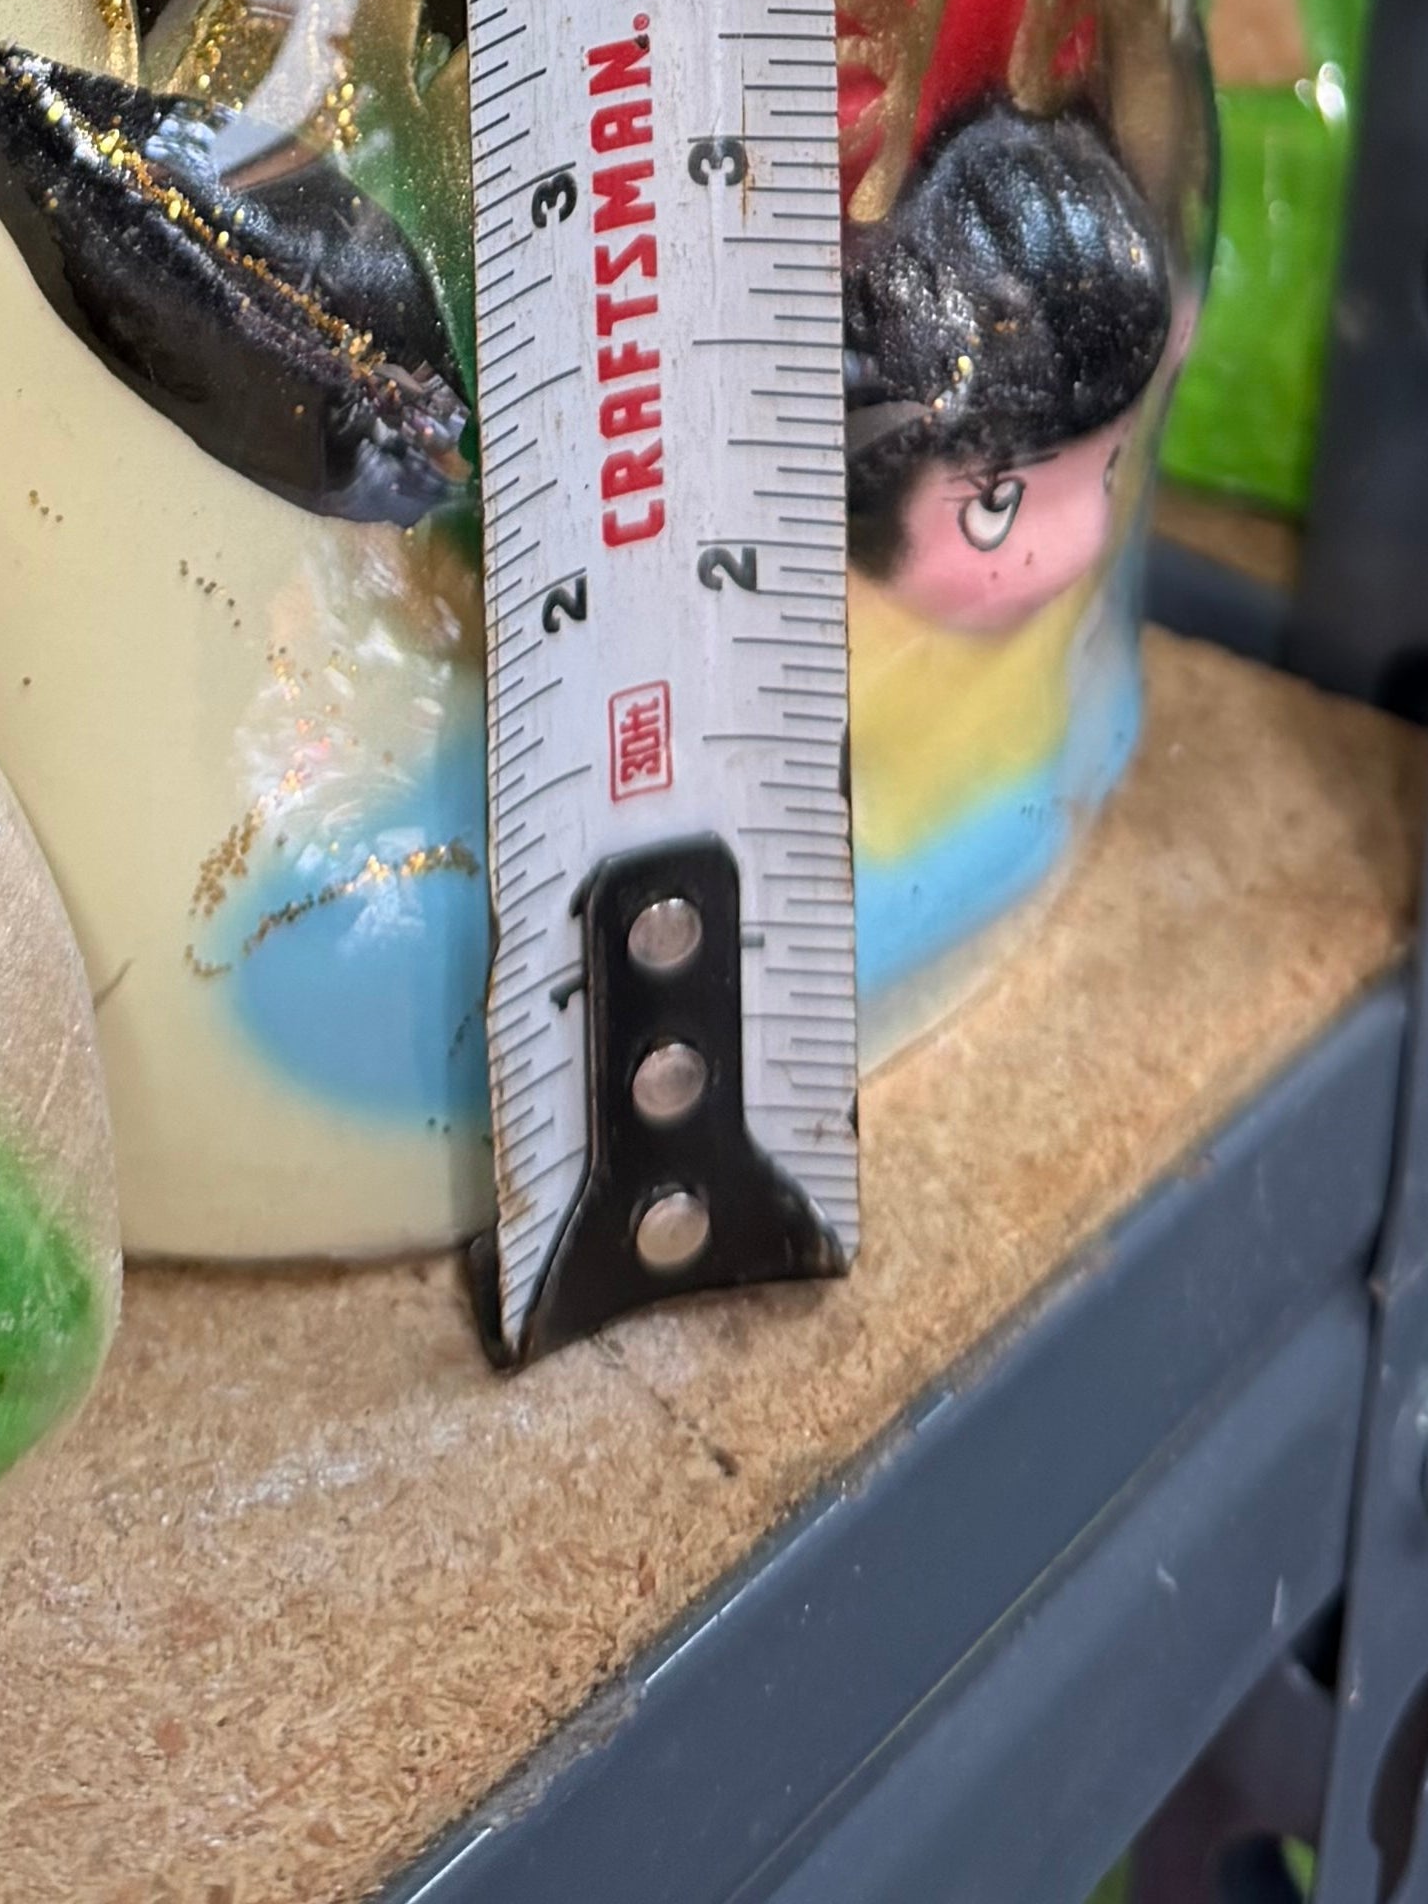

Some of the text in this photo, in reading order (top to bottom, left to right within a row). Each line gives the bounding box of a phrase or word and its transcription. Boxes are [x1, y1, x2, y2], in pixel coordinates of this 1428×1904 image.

[687, 141, 749, 187] 3
[531, 171, 578, 230] 3
[696, 544, 758, 593] 2
[541, 572, 588, 635] 2
